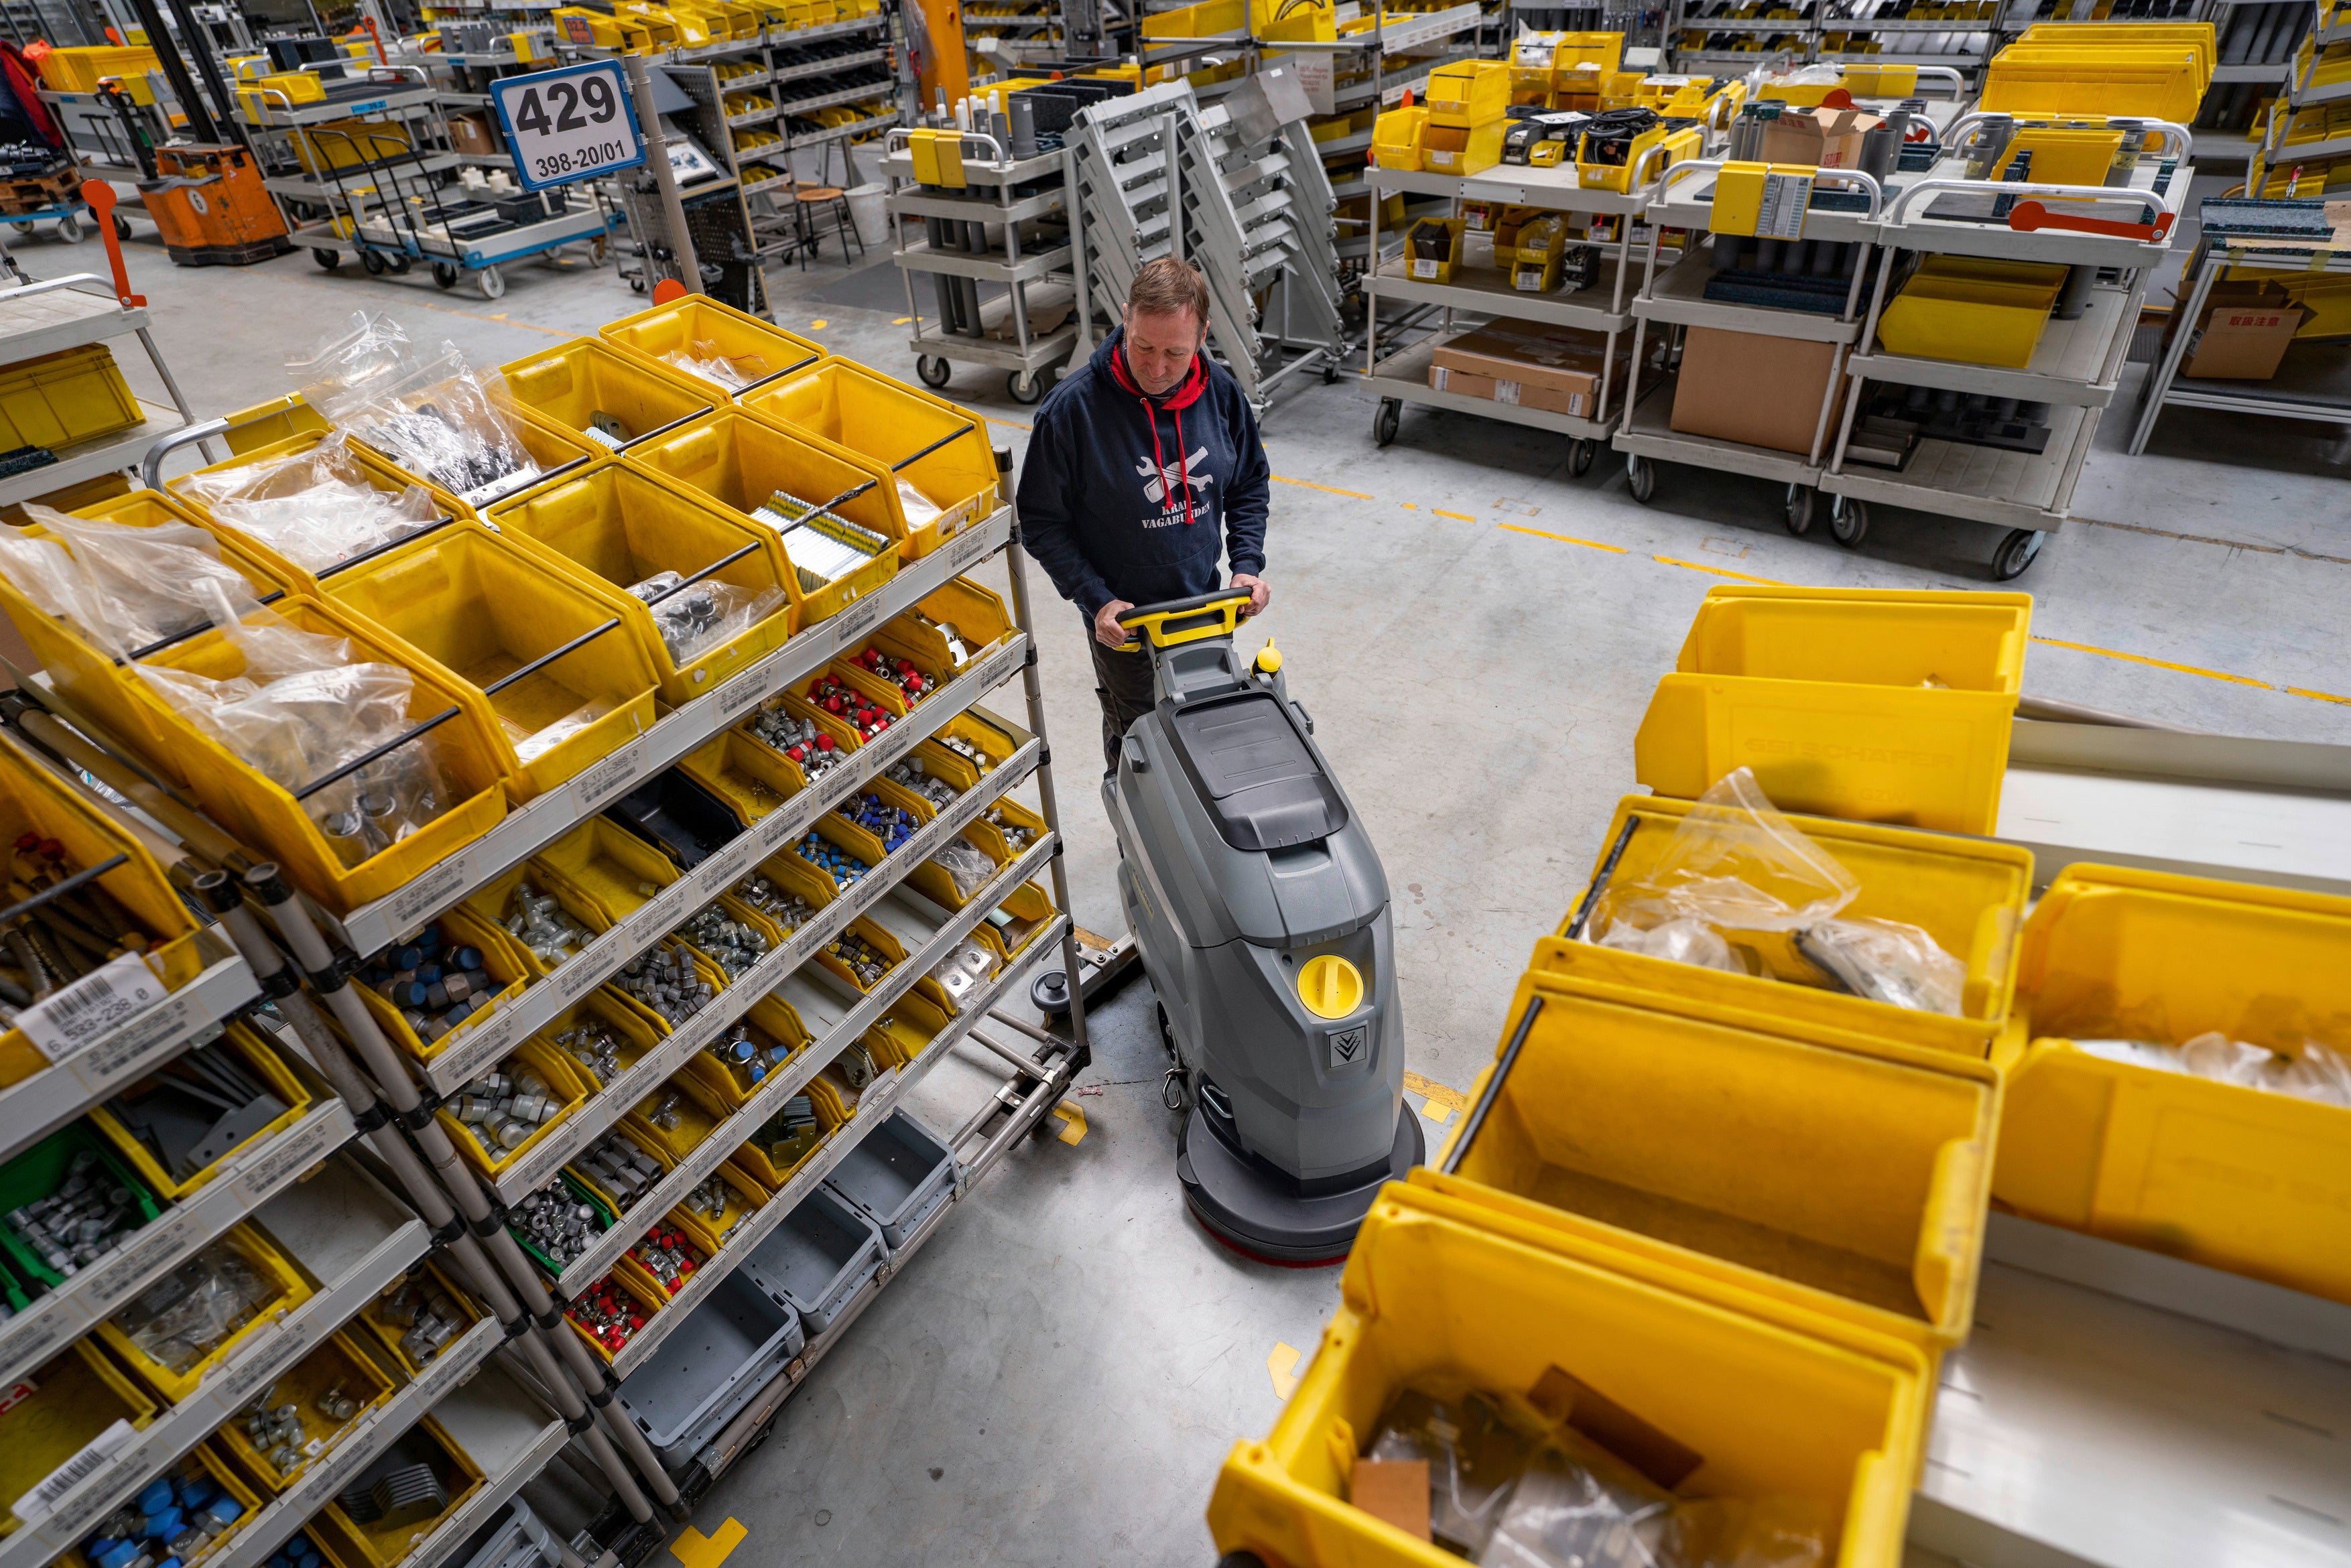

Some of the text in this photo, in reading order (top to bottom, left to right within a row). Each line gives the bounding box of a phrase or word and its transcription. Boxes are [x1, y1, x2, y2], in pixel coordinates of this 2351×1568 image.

[516, 76, 616, 136] 429
[536, 139, 625, 177] 398-20/01
[1161, 501, 1197, 515] KRA-
[871, 726, 911, 756] 6.997-497.0
